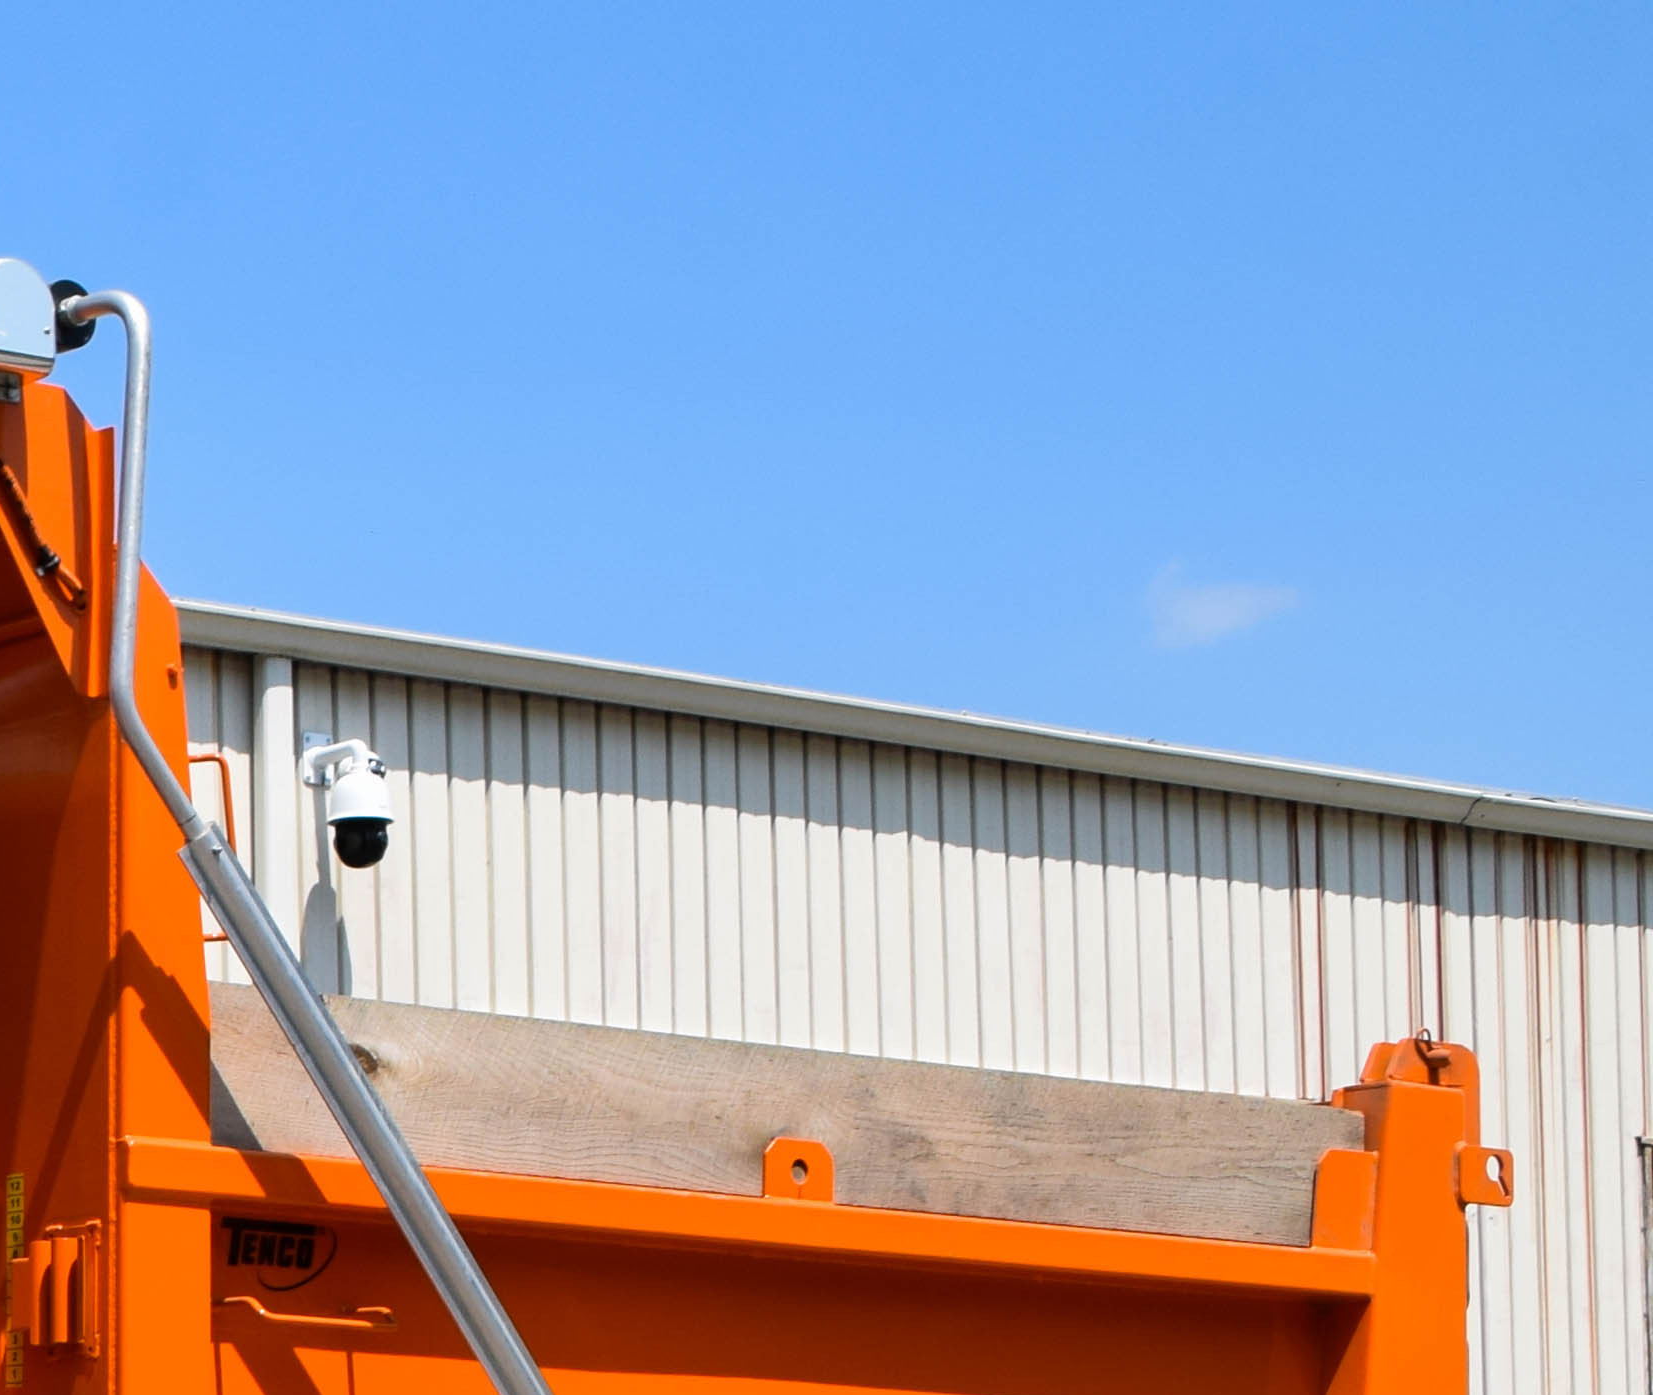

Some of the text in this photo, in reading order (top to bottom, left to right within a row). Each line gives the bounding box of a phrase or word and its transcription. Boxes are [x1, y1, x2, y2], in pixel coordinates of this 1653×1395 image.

[10, 1181, 21, 1192] 12
[10, 1197, 21, 1208] 11
[10, 1214, 21, 1225] 10
[221, 1216, 317, 1269] TENCO
